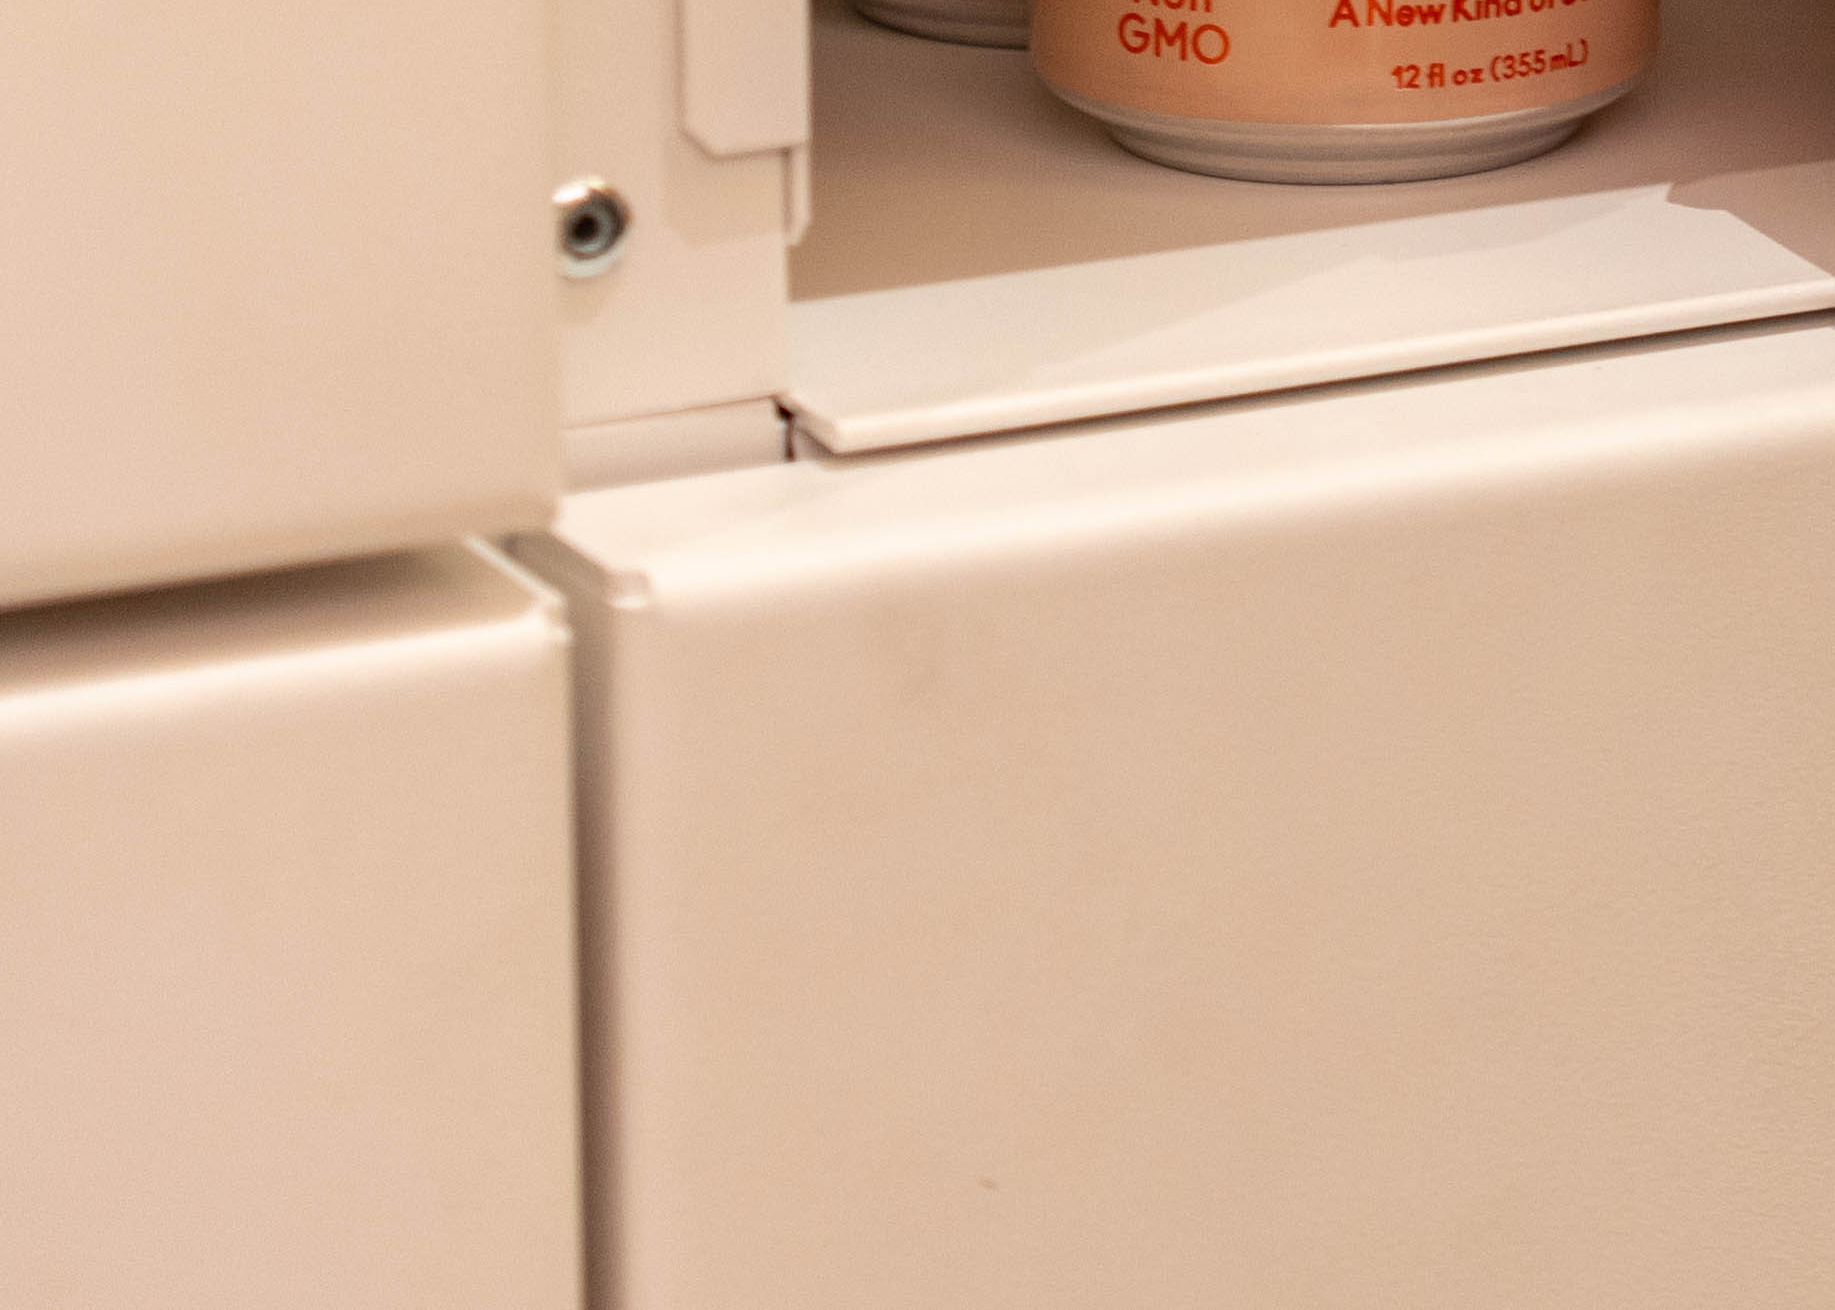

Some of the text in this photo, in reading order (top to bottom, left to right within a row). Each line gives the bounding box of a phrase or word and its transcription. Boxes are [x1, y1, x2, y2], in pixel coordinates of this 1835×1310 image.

[1118, 12, 1231, 65] GMO
[1391, 63, 1421, 89] 12
[1453, 68, 1484, 85] oz
